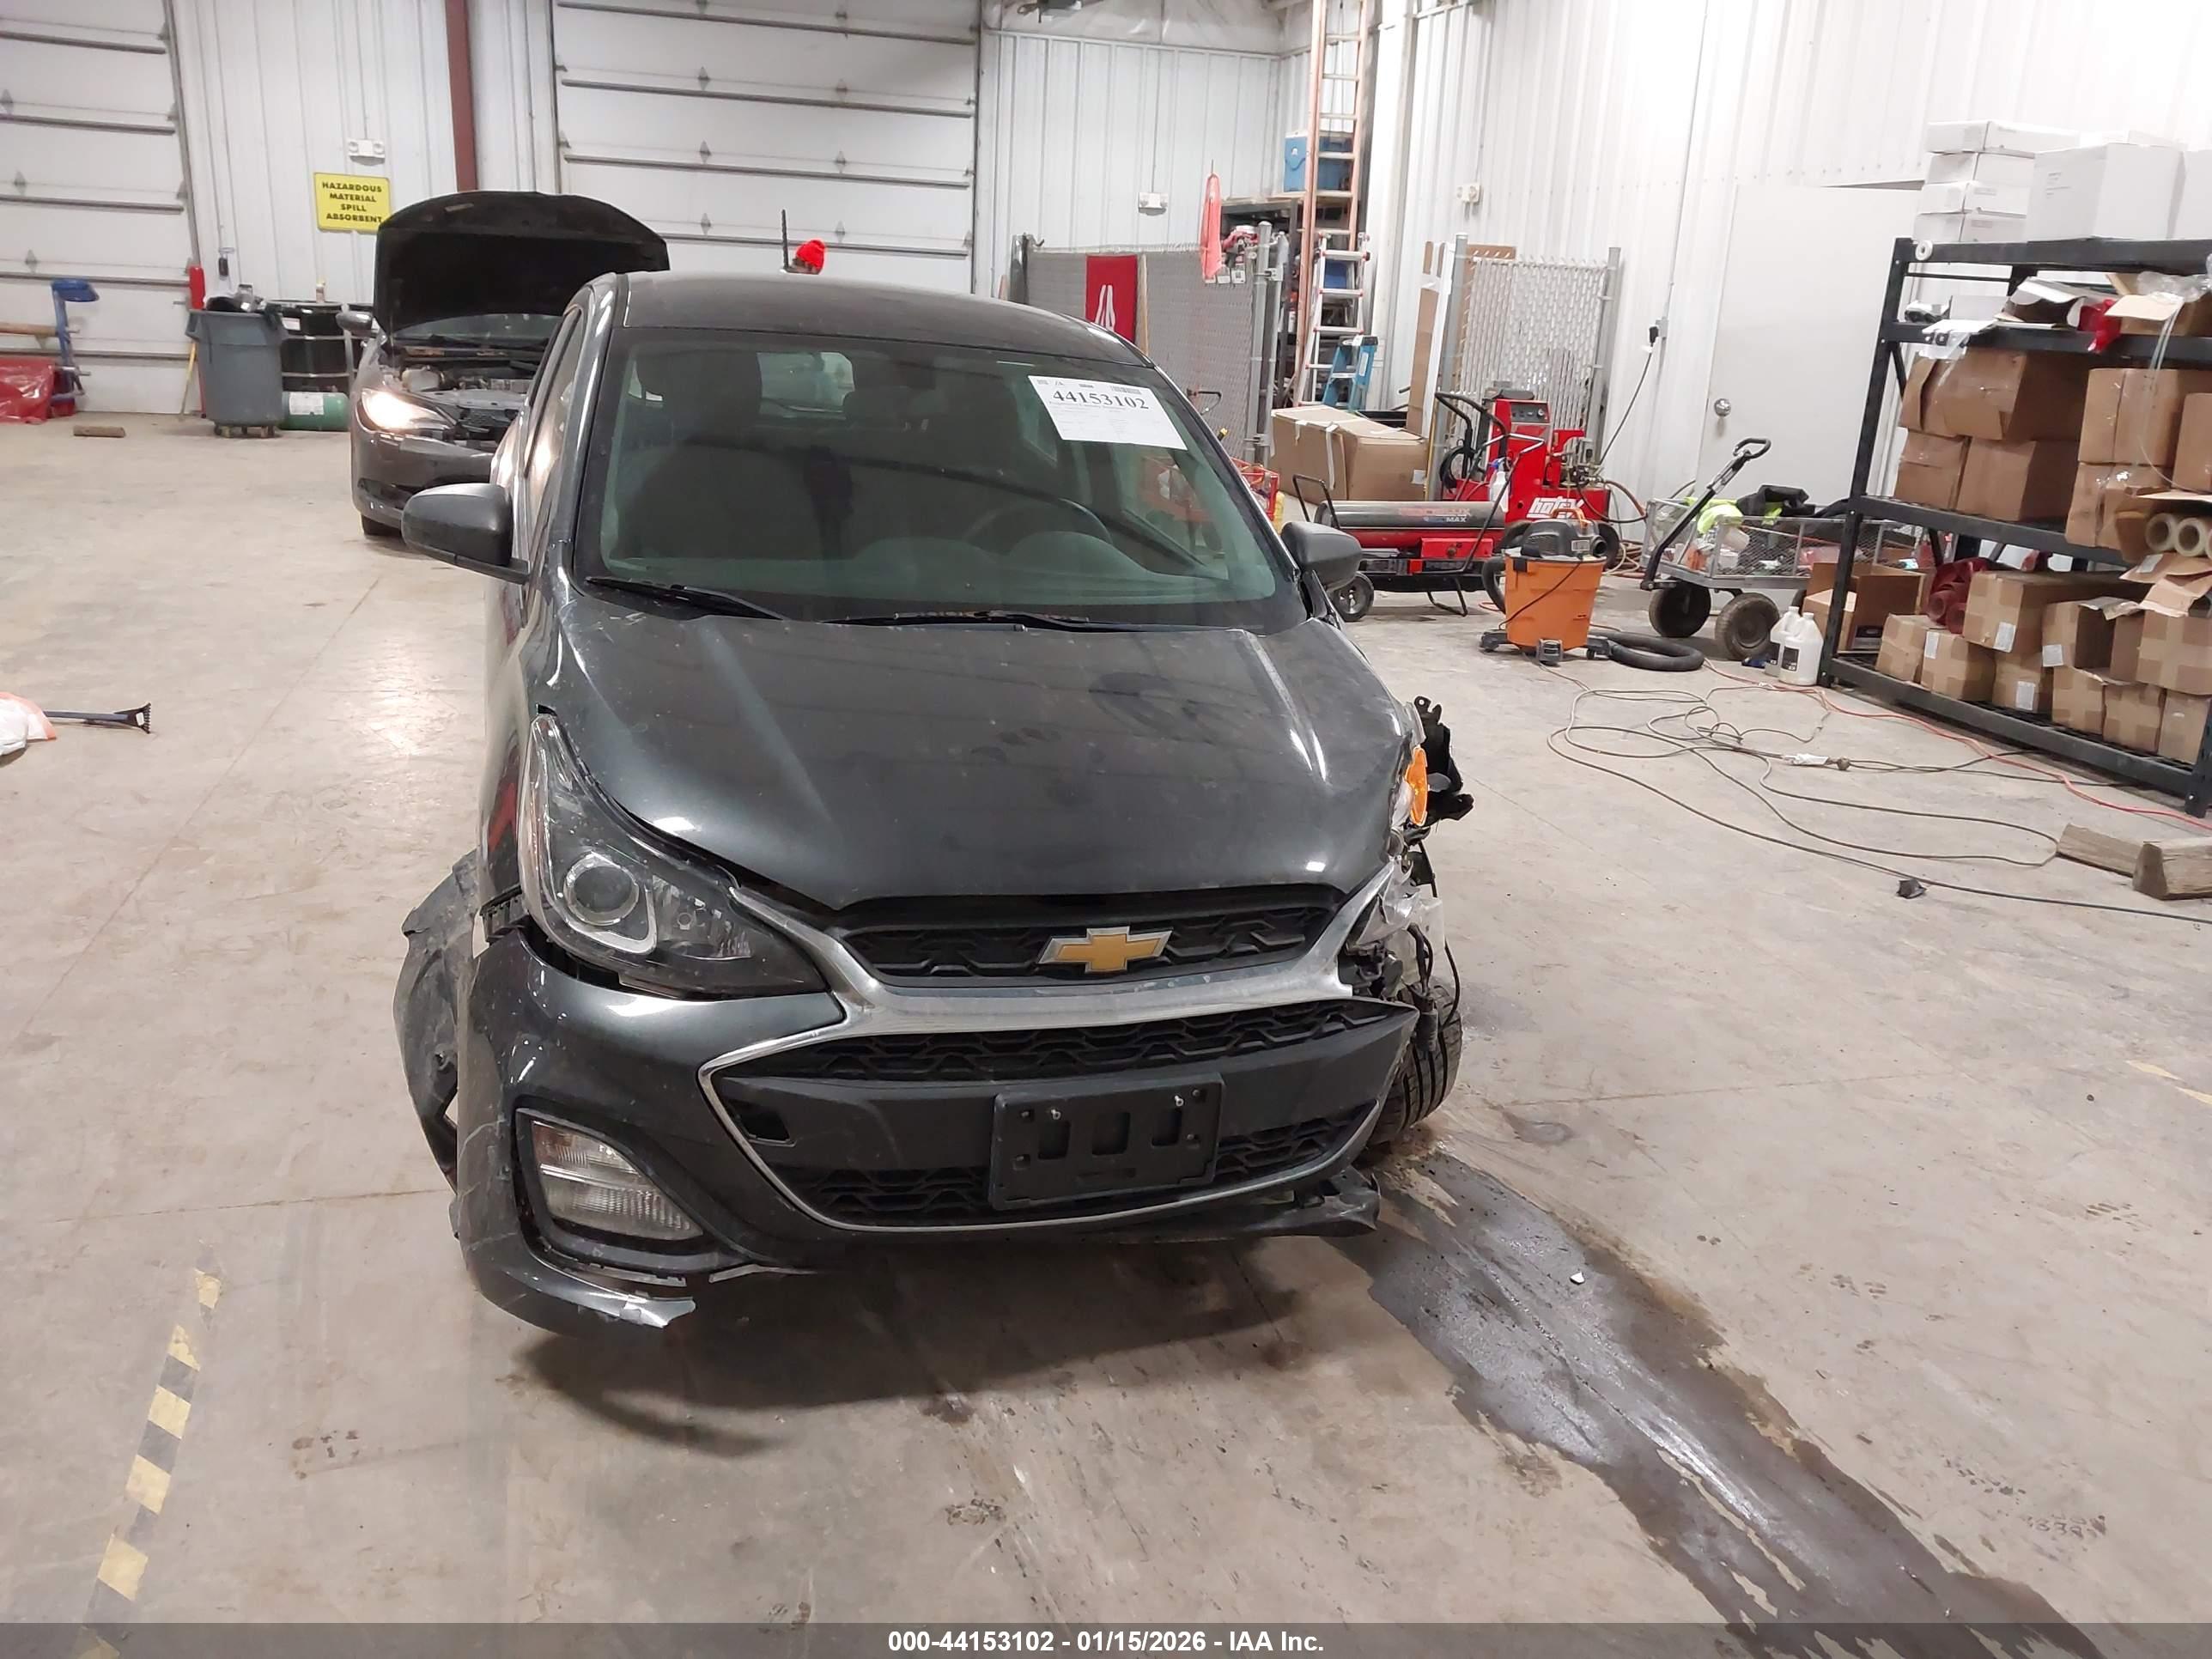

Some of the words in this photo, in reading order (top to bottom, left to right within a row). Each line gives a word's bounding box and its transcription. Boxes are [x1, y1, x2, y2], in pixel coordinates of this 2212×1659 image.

[322, 182, 382, 192] HAZARDOUS
[330, 192, 377, 203] MATERIAL
[341, 204, 367, 212] SPILL
[326, 213, 382, 222] ABSORBENT
[1053, 391, 1150, 410] 44153102
